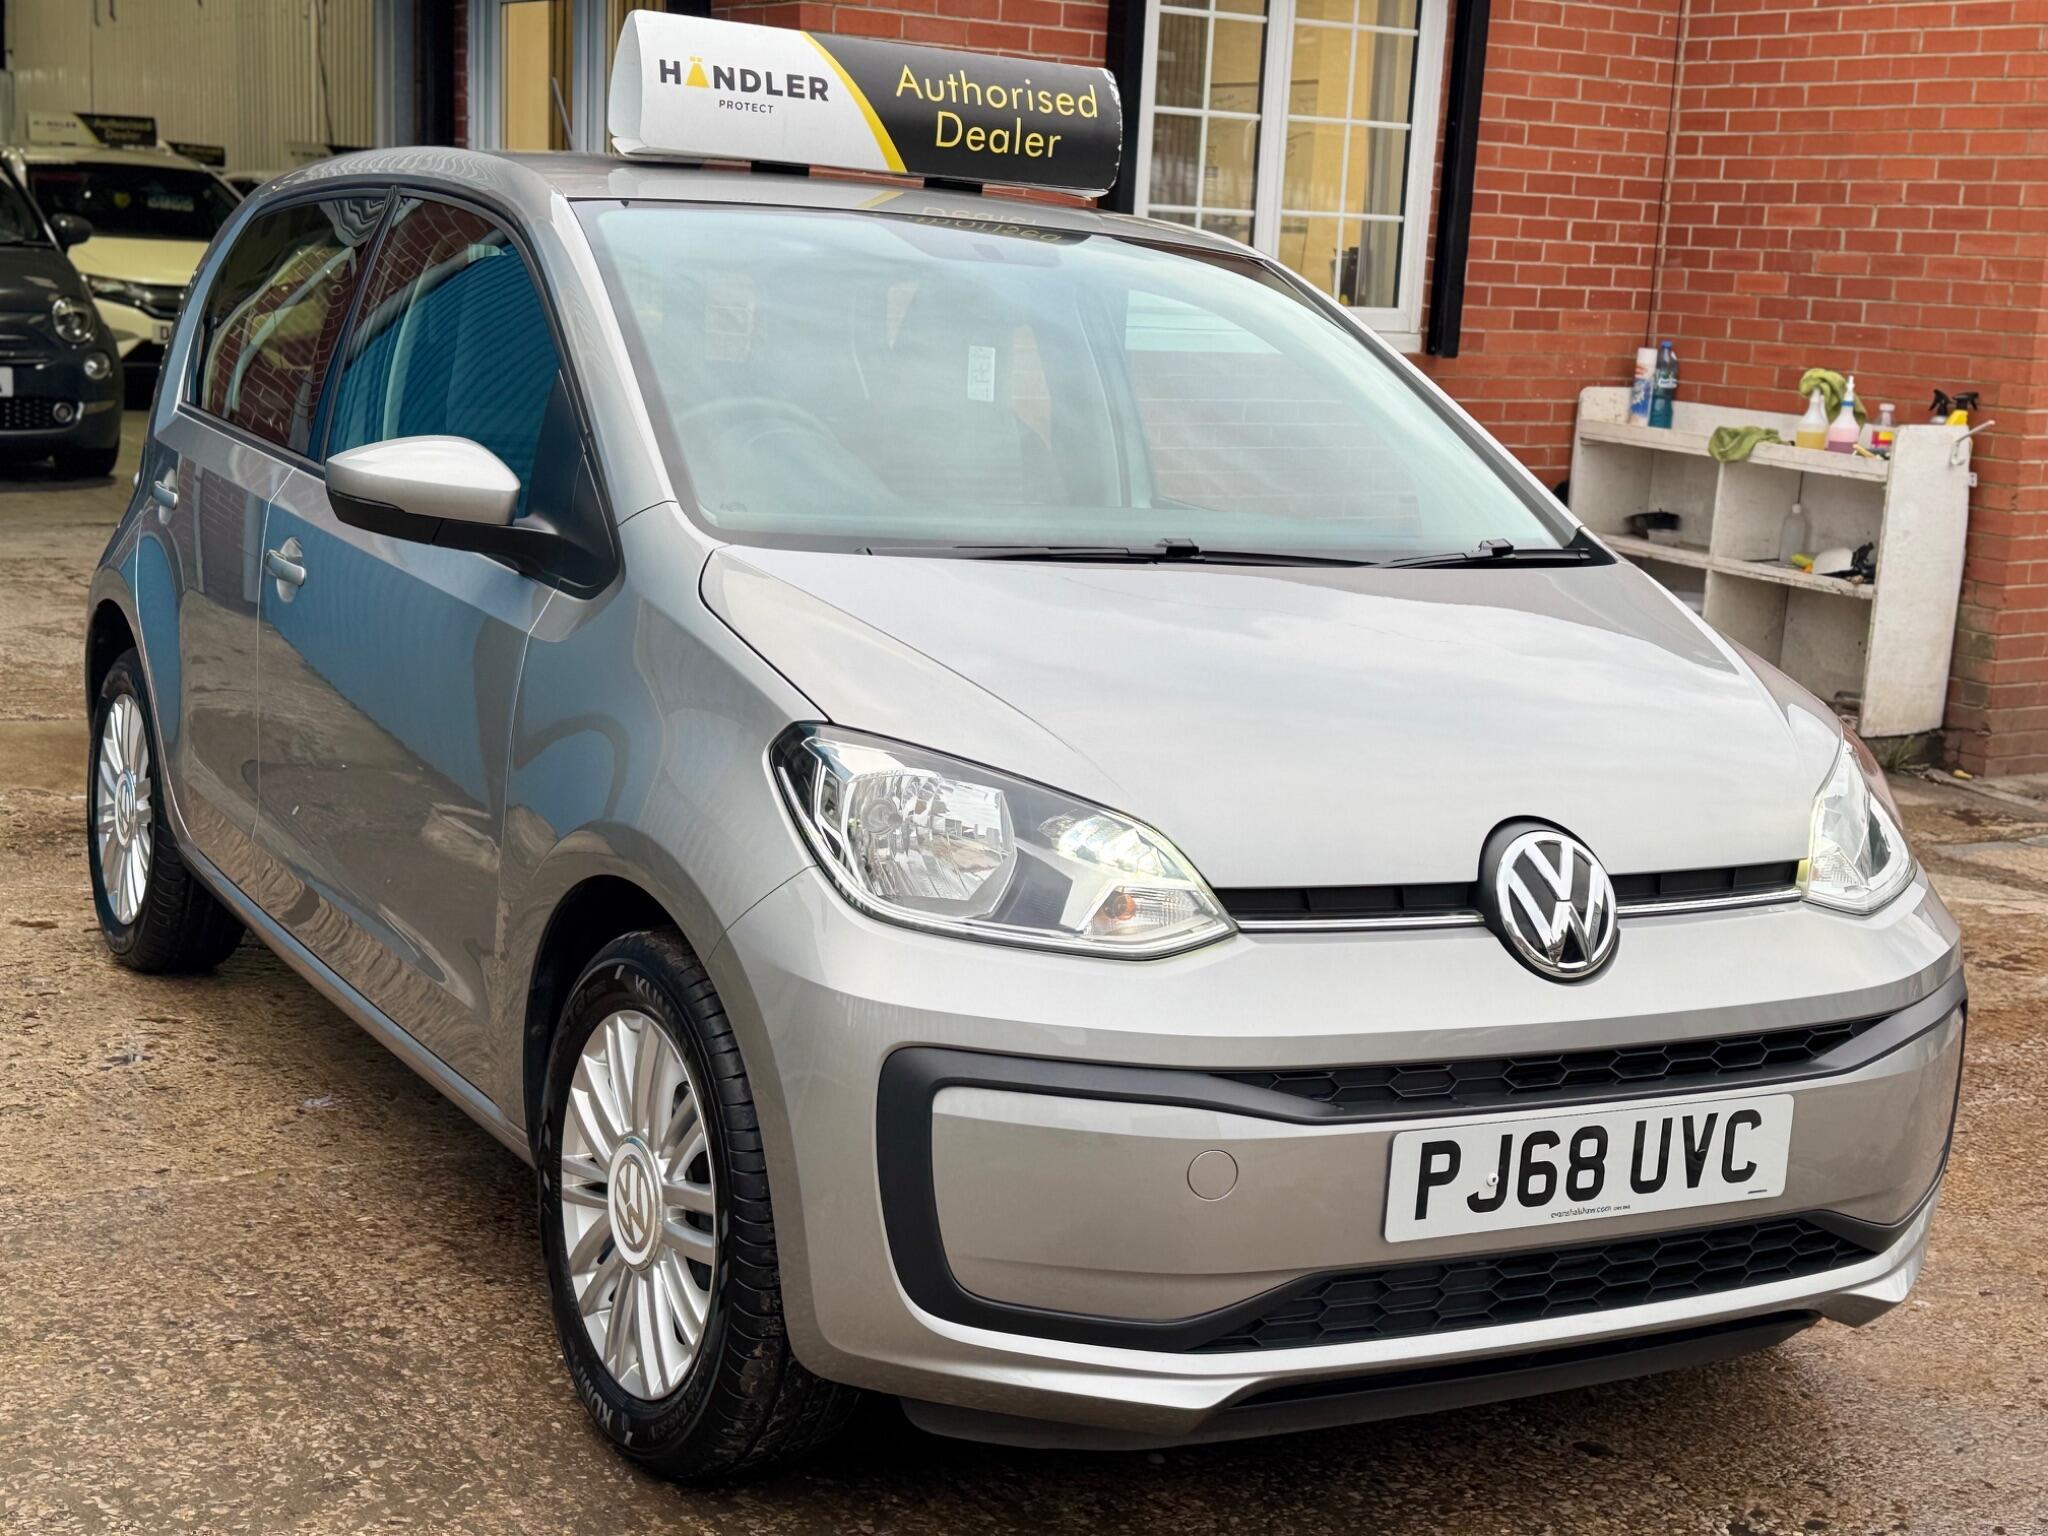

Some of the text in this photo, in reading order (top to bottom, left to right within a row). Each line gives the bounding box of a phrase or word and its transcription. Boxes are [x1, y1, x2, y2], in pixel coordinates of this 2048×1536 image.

[659, 56, 829, 102] HANDLER
[896, 64, 1098, 118] Authorised
[719, 99, 775, 114] PROTECT
[936, 111, 1061, 158] Dealer
[1415, 1109, 1762, 1220] PJ68 UVC
